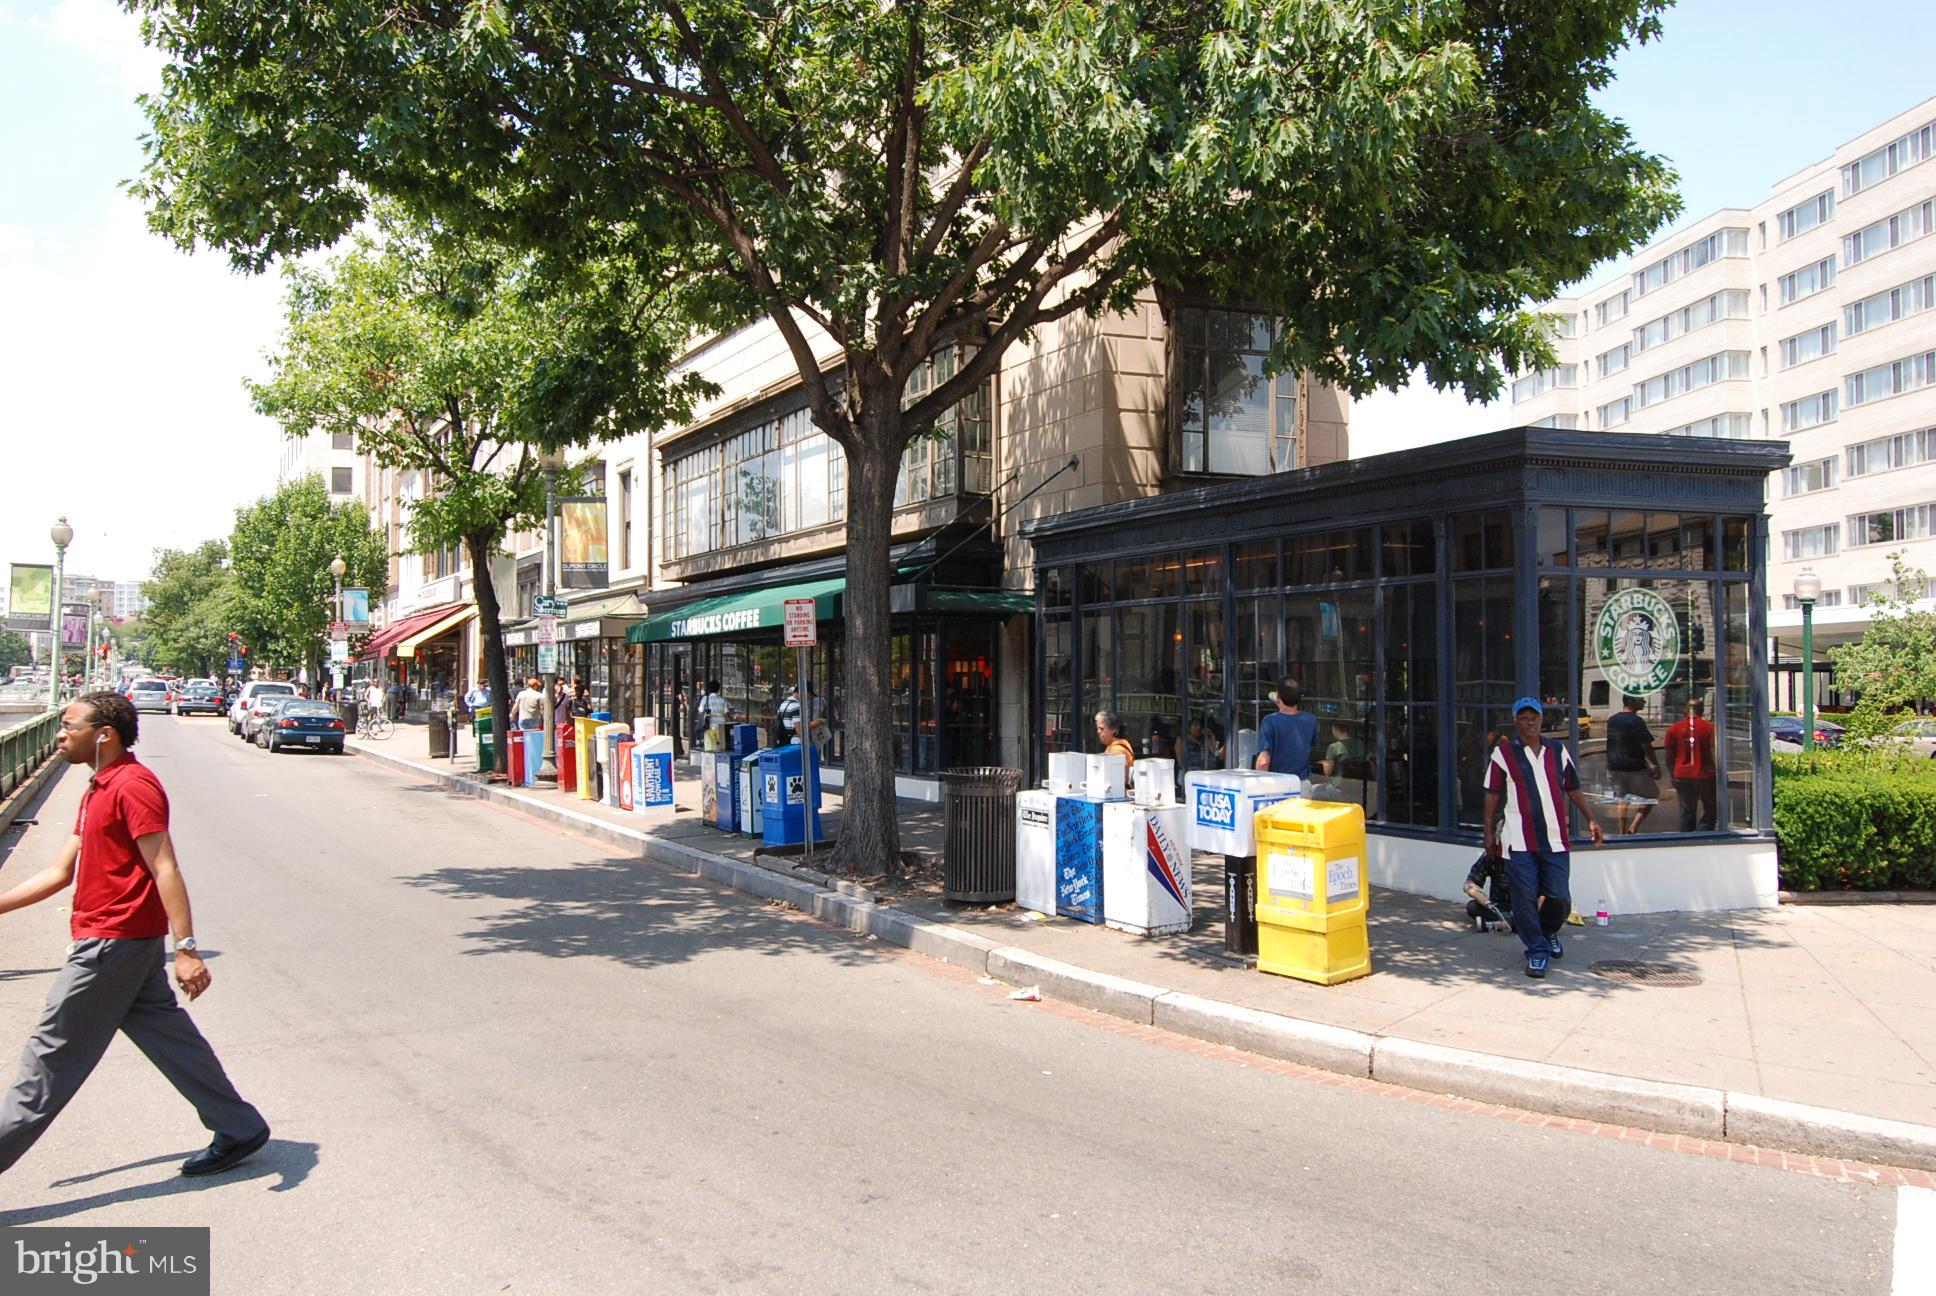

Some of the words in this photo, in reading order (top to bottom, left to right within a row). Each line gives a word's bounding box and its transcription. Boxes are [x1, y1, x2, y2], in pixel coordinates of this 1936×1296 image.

[534, 596, 555, 609] Cary
[671, 615, 722, 638] STARBUCKS
[722, 608, 760, 632] COFFEE
[1600, 593, 1675, 640] STARBUCKS
[1608, 664, 1668, 692] COFFEE
[644, 757, 655, 803] APARTMENT
[654, 767, 662, 802] SHOWCASE
[1209, 793, 1232, 809] USA
[1199, 804, 1232, 824] TODAY
[1150, 816, 1170, 852] DAILY
[1170, 861, 1190, 899] NEWS
[1335, 863, 1344, 871] The
[1063, 867, 1076, 880] The
[1328, 865, 1353, 885] Epoch
[1060, 883, 1073, 897] New
[1072, 874, 1088, 893] York
[1341, 881, 1357, 892] Times
[1070, 889, 1091, 905] Times
